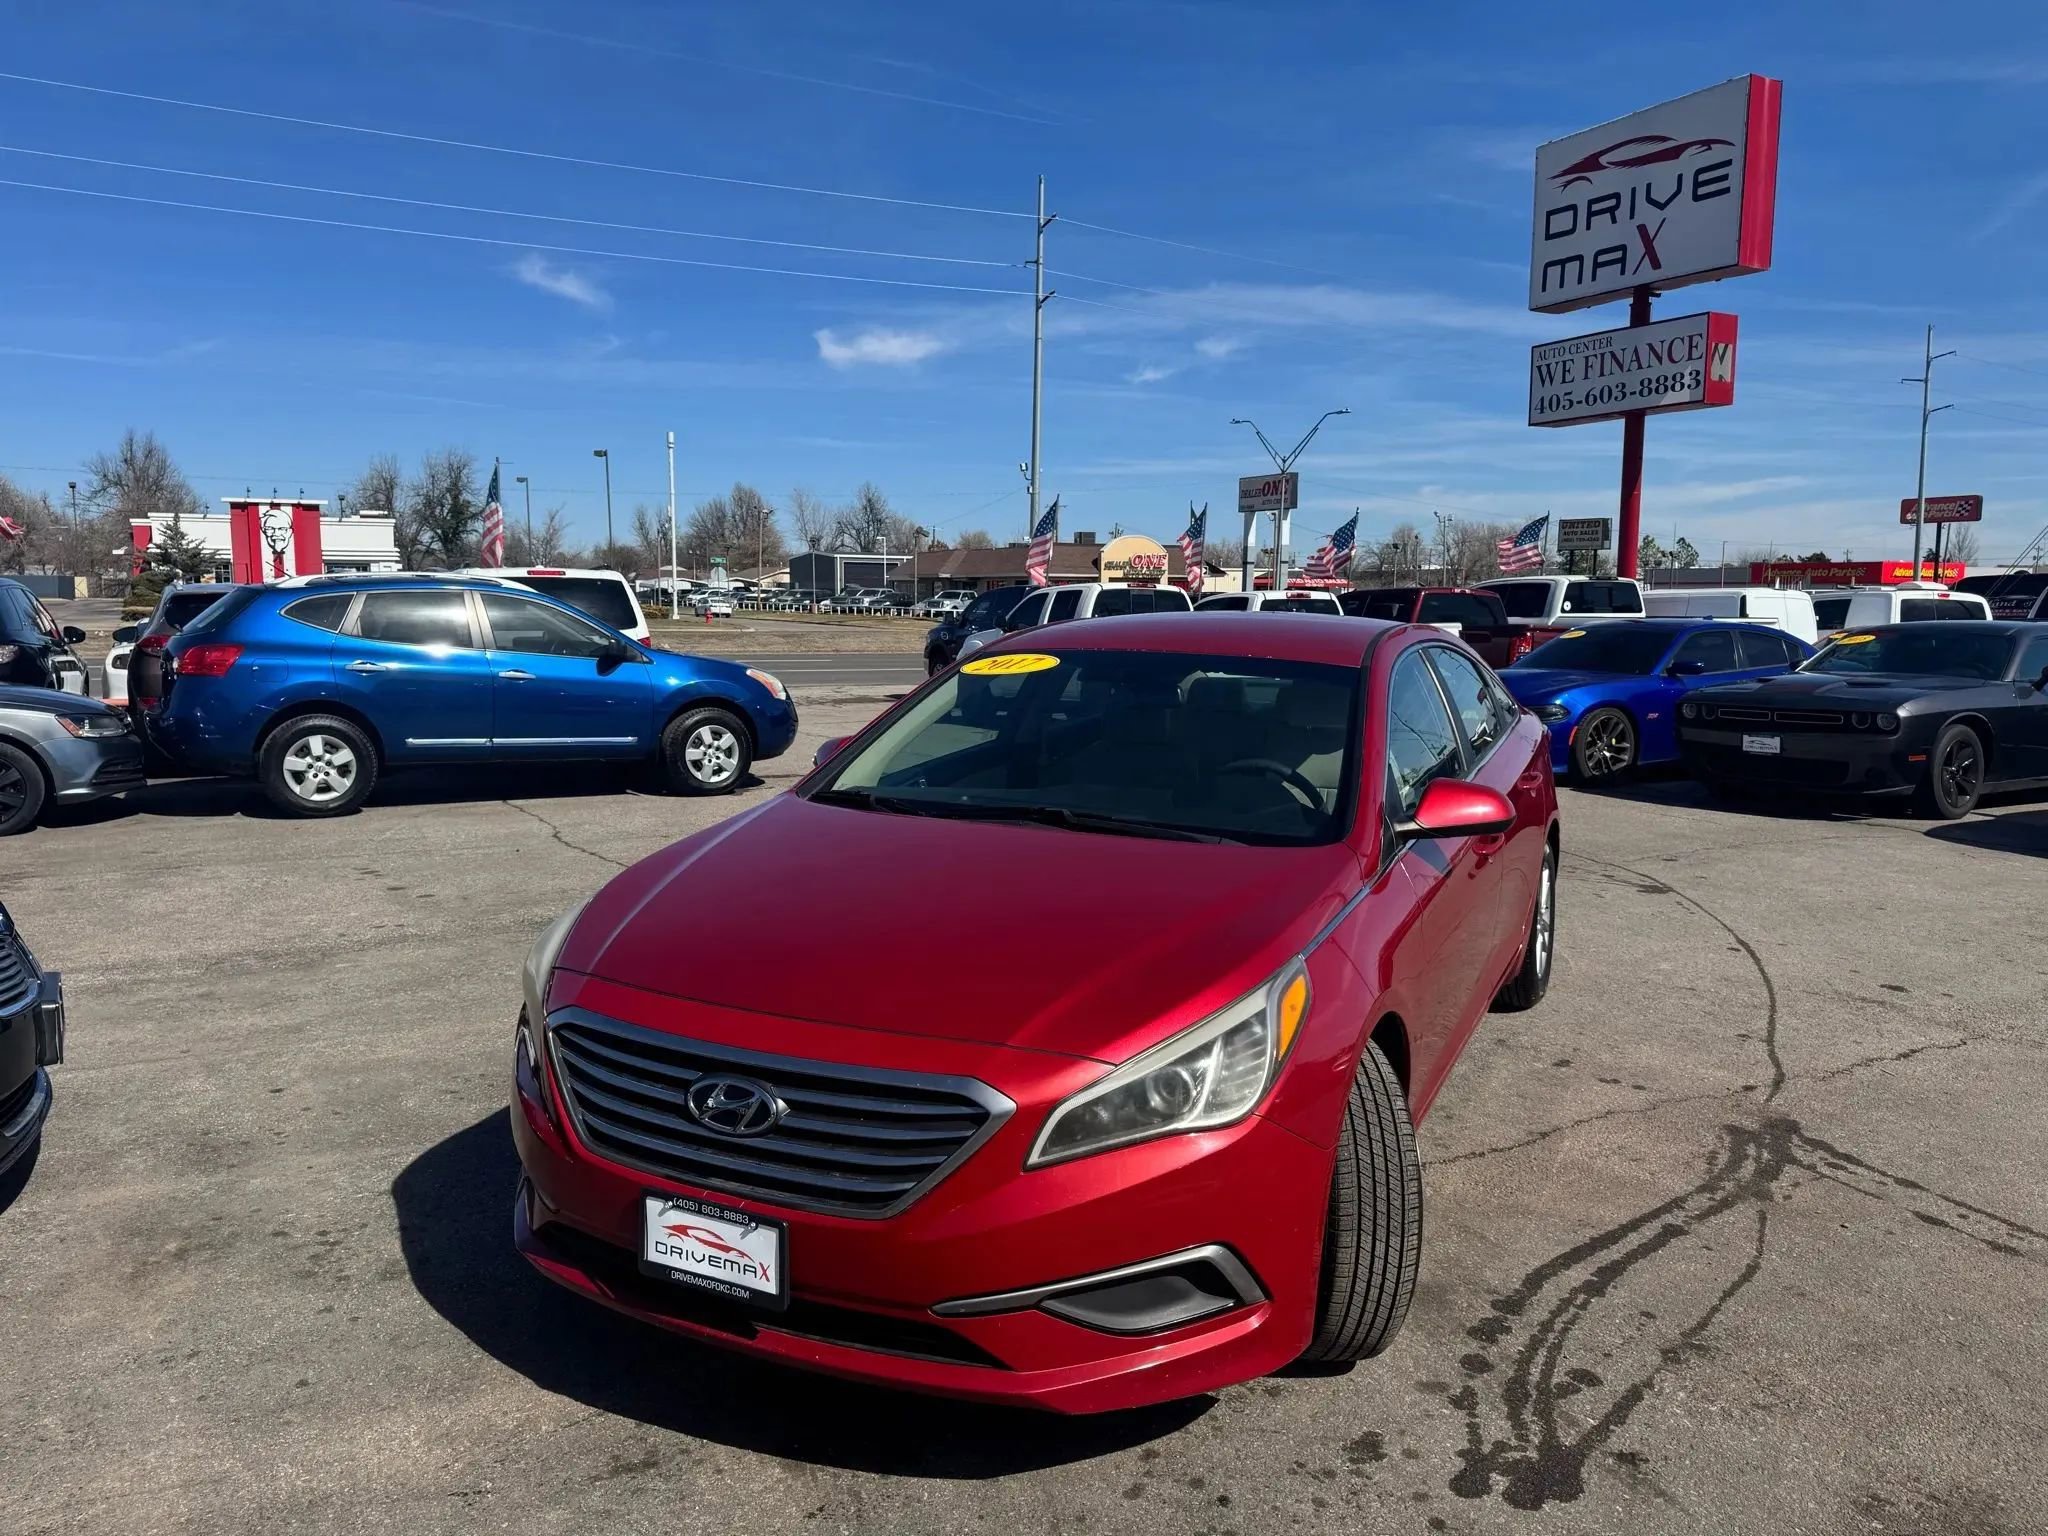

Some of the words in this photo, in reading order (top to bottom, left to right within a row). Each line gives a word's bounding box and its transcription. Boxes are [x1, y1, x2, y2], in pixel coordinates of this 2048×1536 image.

[1545, 158, 1733, 241] DRIVE
[1541, 217, 1667, 293] MAX
[1536, 344, 1565, 362] AUTO
[1569, 336, 1613, 355] CENTER
[1536, 358, 1575, 388] WE
[1582, 333, 1704, 381] FINANCE
[1534, 369, 1701, 415] 405-603-8883
[1562, 521, 1600, 529] UNITED
[1131, 553, 1167, 568] ONE
[1804, 567, 1829, 577] Auto
[1829, 567, 1857, 577] Parts
[971, 658, 1047, 671] 2017
[673, 1197, 699, 1211] (405)
[701, 1205, 749, 1224] 603-8883
[655, 1240, 771, 1283] DRIVEMAX
[671, 1270, 750, 1299] DRIVEMAXOFOKC.COM
